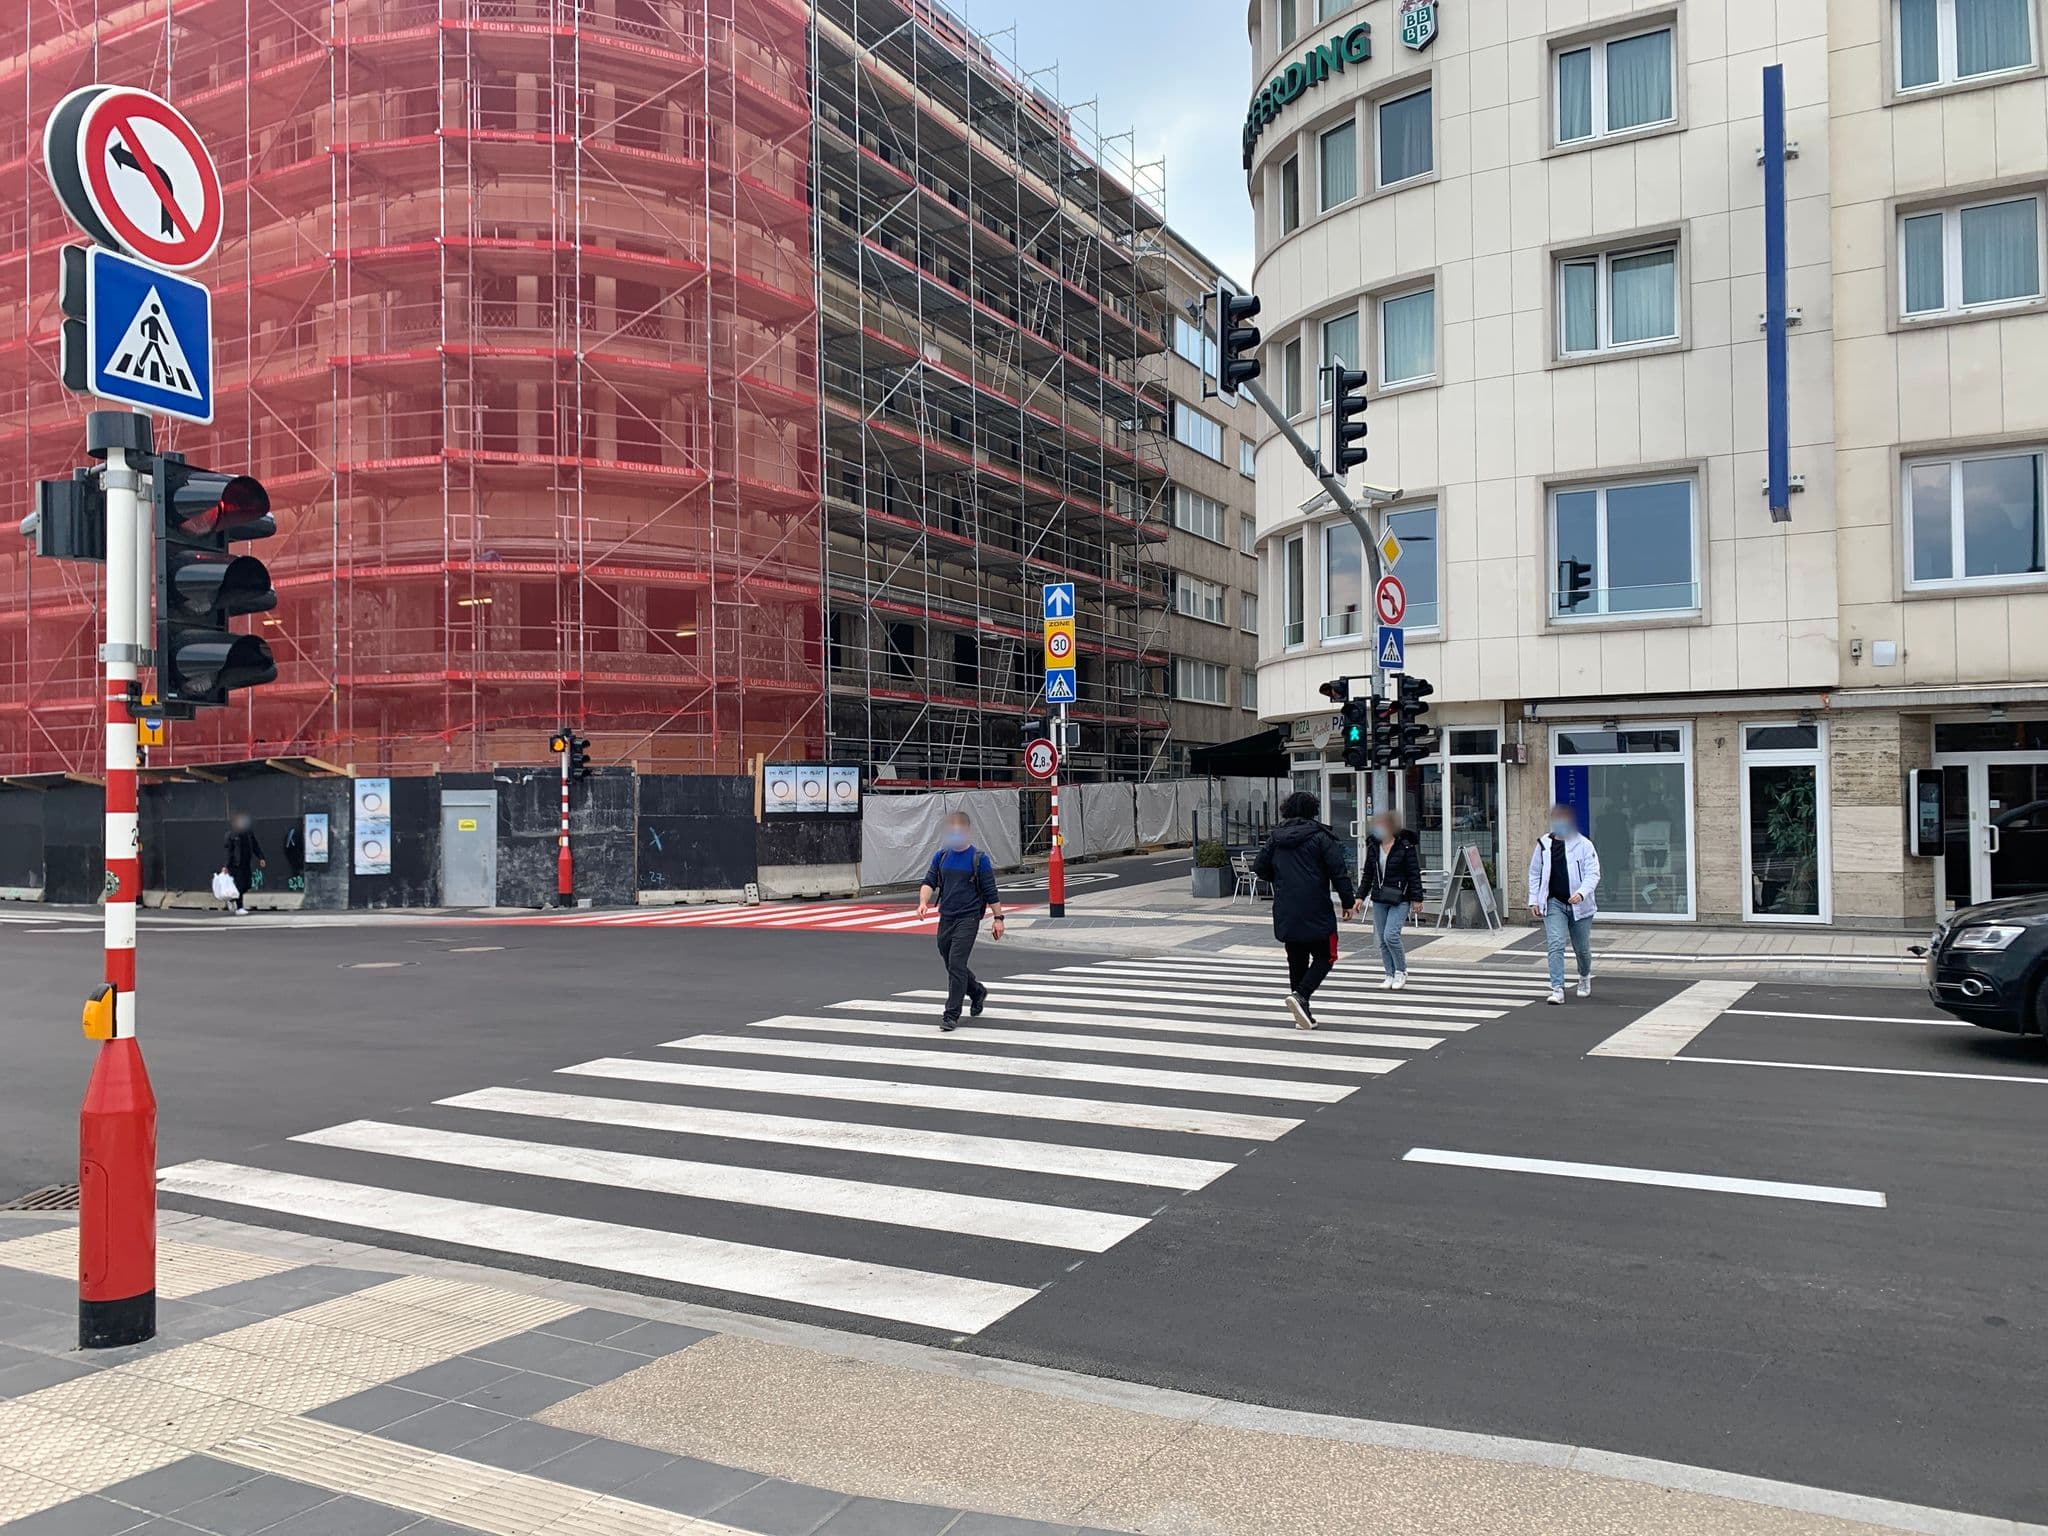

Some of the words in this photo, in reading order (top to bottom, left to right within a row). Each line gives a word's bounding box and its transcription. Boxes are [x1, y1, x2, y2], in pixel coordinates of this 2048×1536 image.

[624, 568, 699, 580] ECHAFAUDAGES
[1053, 639, 1067, 651] 30
[1295, 719, 1311, 735] PIZZA
